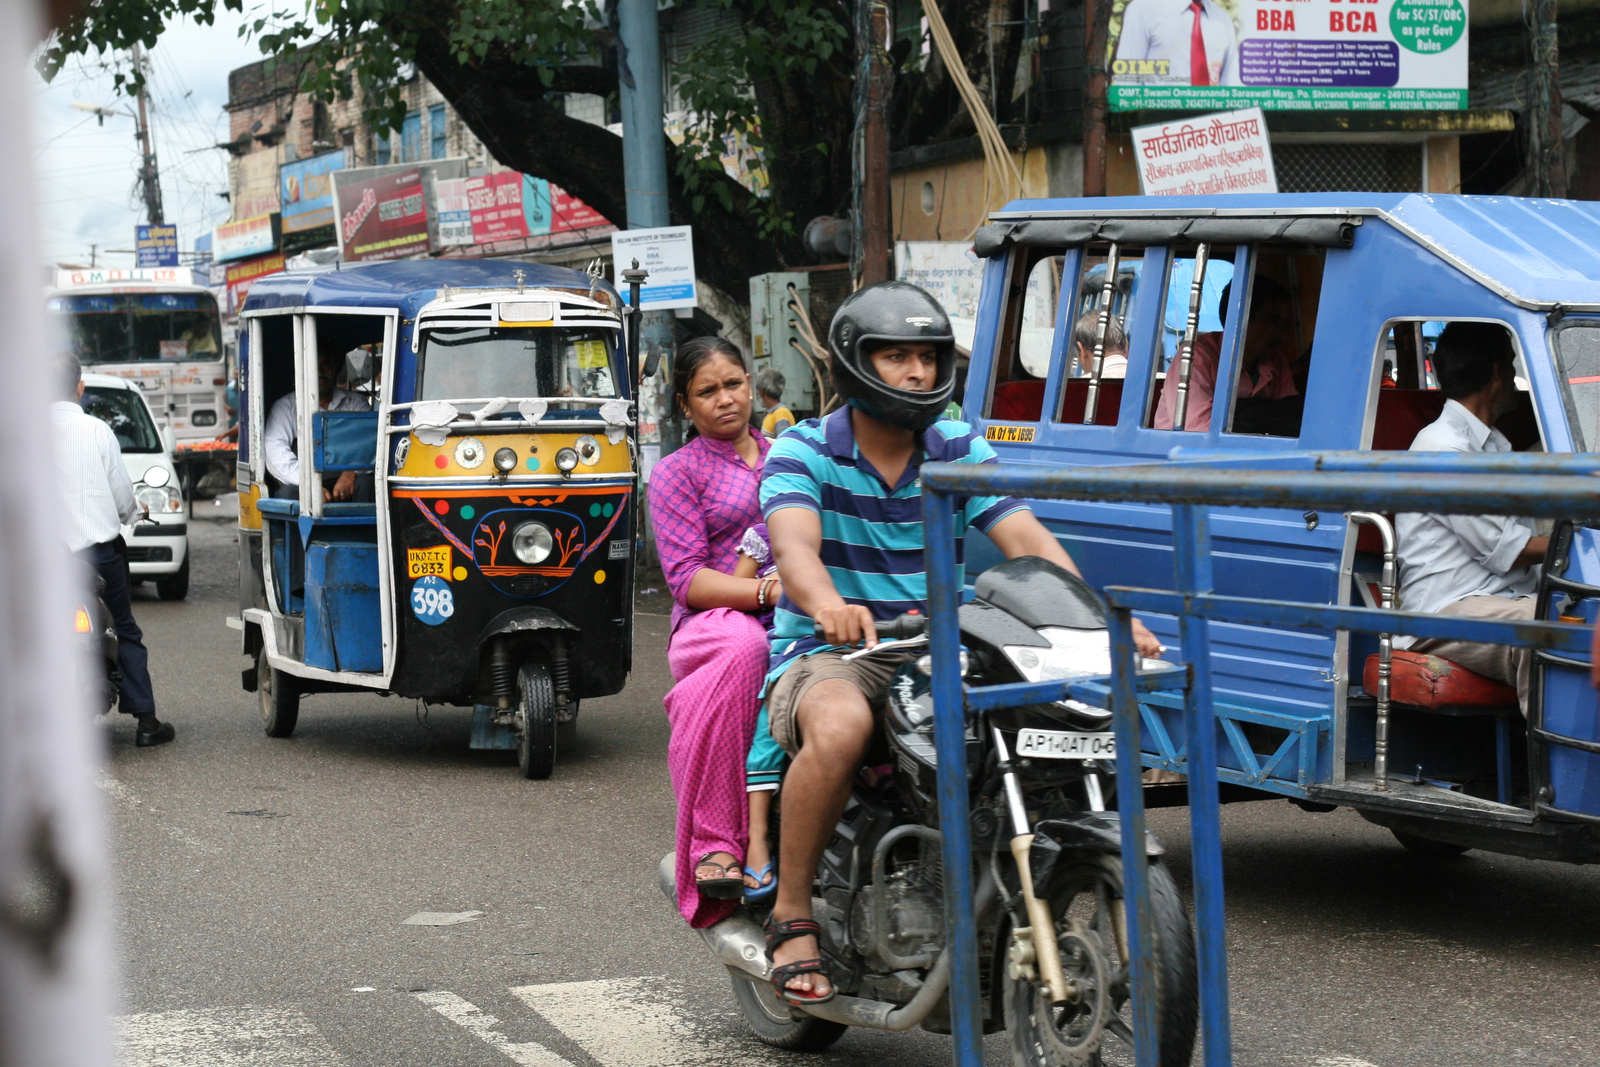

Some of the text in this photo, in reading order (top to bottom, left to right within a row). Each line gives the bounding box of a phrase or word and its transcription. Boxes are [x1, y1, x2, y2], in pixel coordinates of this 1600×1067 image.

[1256, 9, 1295, 32] BBA
[1329, 11, 1378, 33] BCA
[1396, 8, 1462, 23] for SC/ST/OBC
[1402, 24, 1454, 38] as per Govt
[1417, 38, 1442, 51] Rules
[1112, 60, 1170, 75] OIMT
[1118, 88, 1142, 98] OIMT,
[1144, 88, 1171, 97] Swami
[1173, 88, 1230, 97] Omkarananda
[1231, 88, 1271, 98] Saraswati
[1142, 119, 1260, 159] सार्वजनिक शौचालय
[412, 562, 444, 574] 0833
[413, 588, 454, 618] 398
[891, 675, 925, 725] Apache
